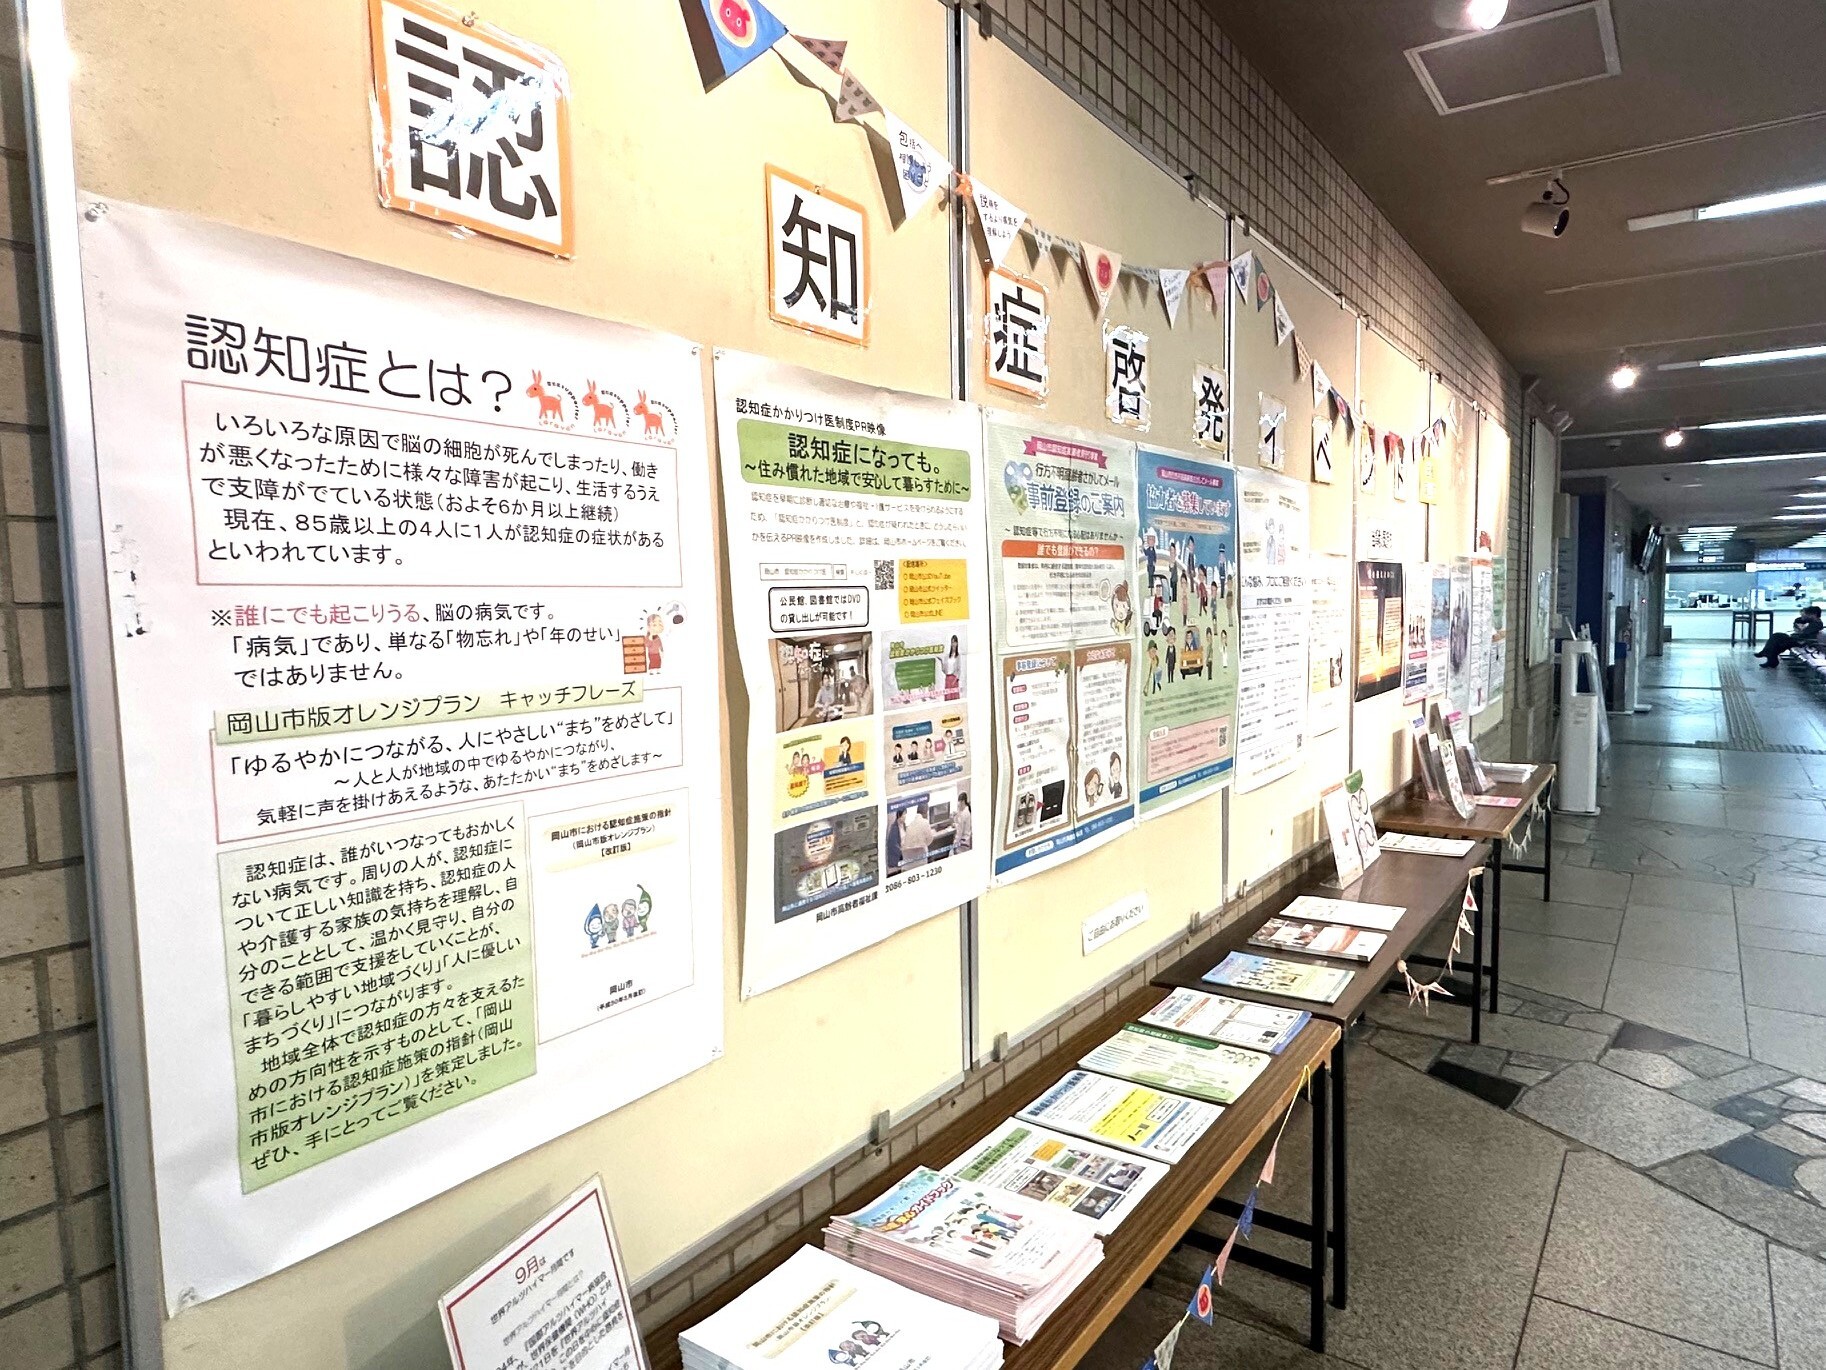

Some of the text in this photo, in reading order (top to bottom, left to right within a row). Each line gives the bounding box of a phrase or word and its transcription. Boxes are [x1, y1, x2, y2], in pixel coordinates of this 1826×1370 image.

[395, 17, 558, 220] 認
[781, 194, 858, 325] 知
[993, 286, 1042, 383] 症
[1112, 338, 1146, 419] 啓
[1199, 376, 1224, 442] 発
[1264, 413, 1279, 464] イ
[185, 313, 513, 412] 認知症とは？
[216, 412, 658, 479] いろいろな原因で脳の細胞が死んでしまったり、働き
[736, 398, 887, 436] 認知症かかりつけ医制度PR映像
[200, 441, 660, 502] が悪くなったために様々な障害が起こり、生活するうえ
[745, 460, 970, 495] ～住み慣れた地域で安心して暮らすために～
[788, 432, 940, 474] 認知症になっても。
[1027, 482, 1125, 517] 事前登録のご案内
[209, 538, 403, 566] といわれています。
[211, 602, 554, 627] ※誰にでも起こりうる、脳の病気です。
[233, 627, 620, 657] 「病気」であり、単なる「物忘れ」や「年のせい」
[227, 680, 636, 735] 岡山市版オレンジプラン キャッチフレーズ
[235, 662, 402, 687] ではありません。
[232, 839, 512, 909] ない病気です。周りの人が、認知症に
[246, 816, 515, 882] 認知症は、誰がいつなってもおかしく
[235, 858, 516, 931] ついて正しい知識を持ち、認知症の人
[238, 876, 518, 956] や介護する家族の気持ちを理解し、自
[239, 898, 514, 982] 分のこととして、温かく見守り、自分の
[241, 923, 499, 1003] できる範囲で支援をしていくことが、
[243, 937, 520, 1028] 「暮らしやすい地域づくり」「人に優しい
[245, 979, 453, 1055] まちづくり」につながります。
[249, 999, 512, 1100] めの方向性を示すものとして、「岡山
[261, 975, 525, 1074] 地域全体で認知症の方々を支えるた
[249, 1017, 512, 1124] 市における認知症施策の指針（岡山
[250, 1037, 523, 1147] 市版オレンジプラン）」を策定しました。
[251, 1075, 476, 1171] ぜひ、手にとってご覧ください。
[515, 1255, 546, 1285] 9月は
